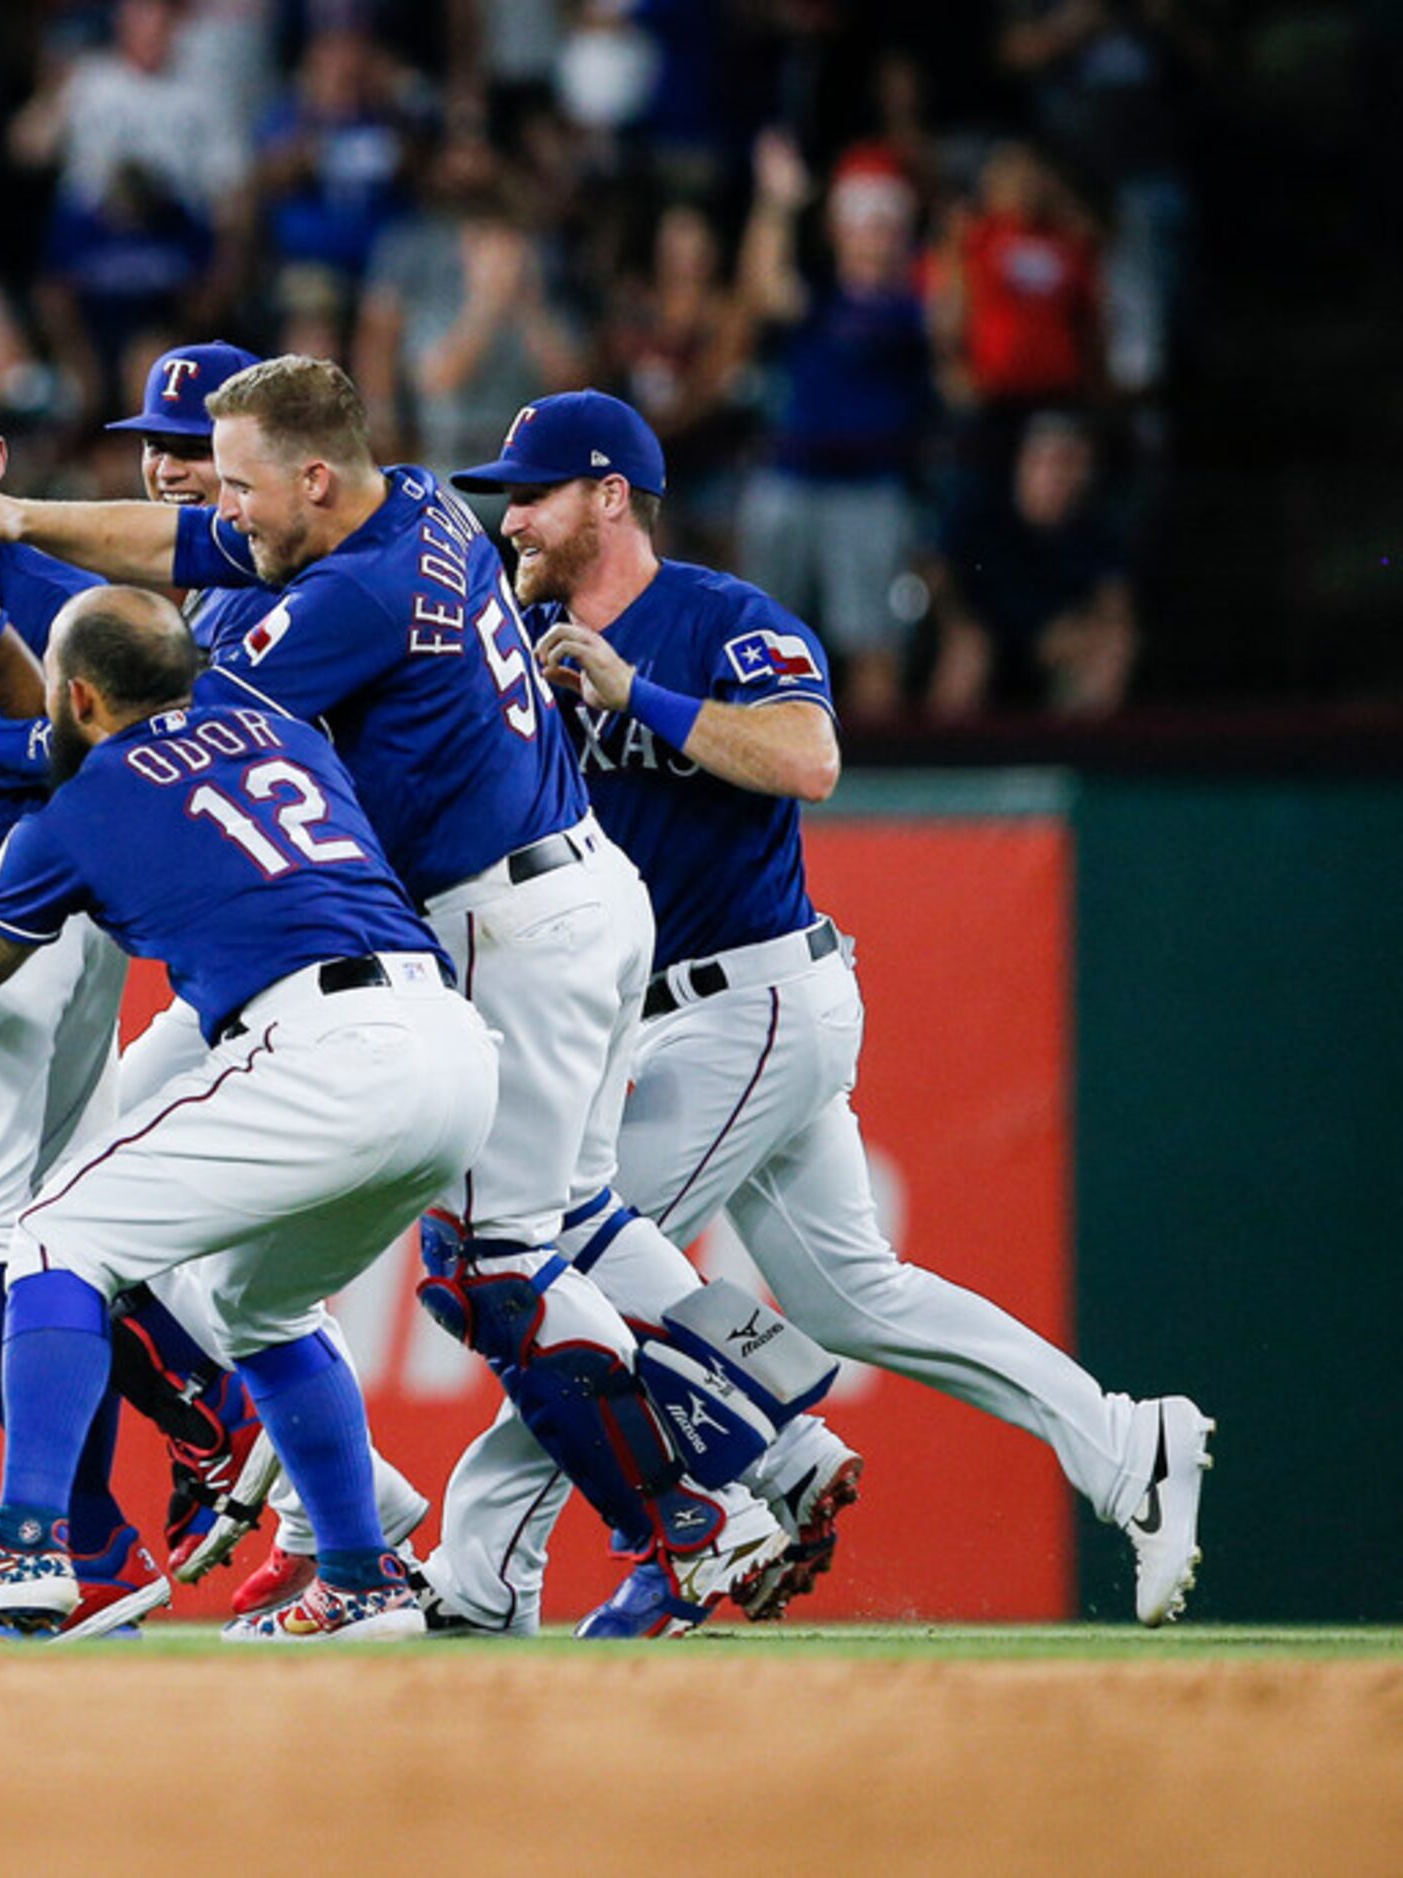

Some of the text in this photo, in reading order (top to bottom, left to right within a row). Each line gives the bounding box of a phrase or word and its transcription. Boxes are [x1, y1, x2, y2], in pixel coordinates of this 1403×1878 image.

[161, 359, 200, 401] T
[471, 567, 556, 741] 5
[123, 707, 286, 785] ODOR
[184, 755, 371, 880] 12
